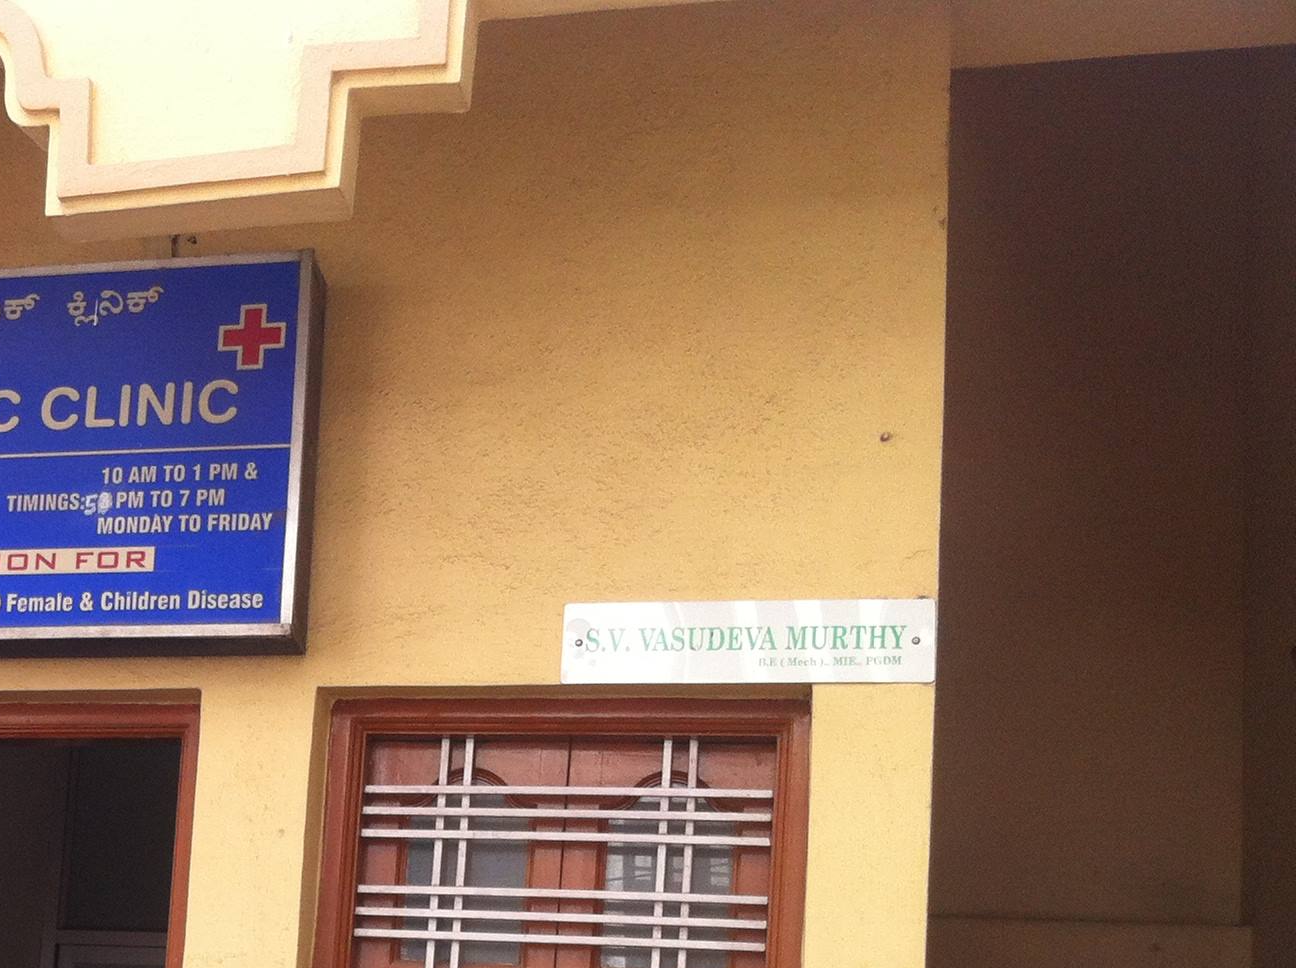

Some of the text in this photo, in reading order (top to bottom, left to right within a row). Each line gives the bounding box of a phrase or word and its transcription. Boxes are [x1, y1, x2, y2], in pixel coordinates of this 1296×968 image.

[40, 378, 240, 431] CLINIC
[101, 462, 259, 484] 10 AM TO 1 PM &
[115, 491, 144, 509] PM
[150, 490, 172, 508] TO
[179, 489, 191, 507] 7
[195, 488, 225, 506] PM
[96, 512, 273, 535] MONDAY TO FRIDAY
[75, 549, 147, 571] FOR
[6, 588, 264, 613] Female & Children Disease
[638, 625, 777, 652] VASUDEVA
[784, 624, 907, 651] MURTHY
